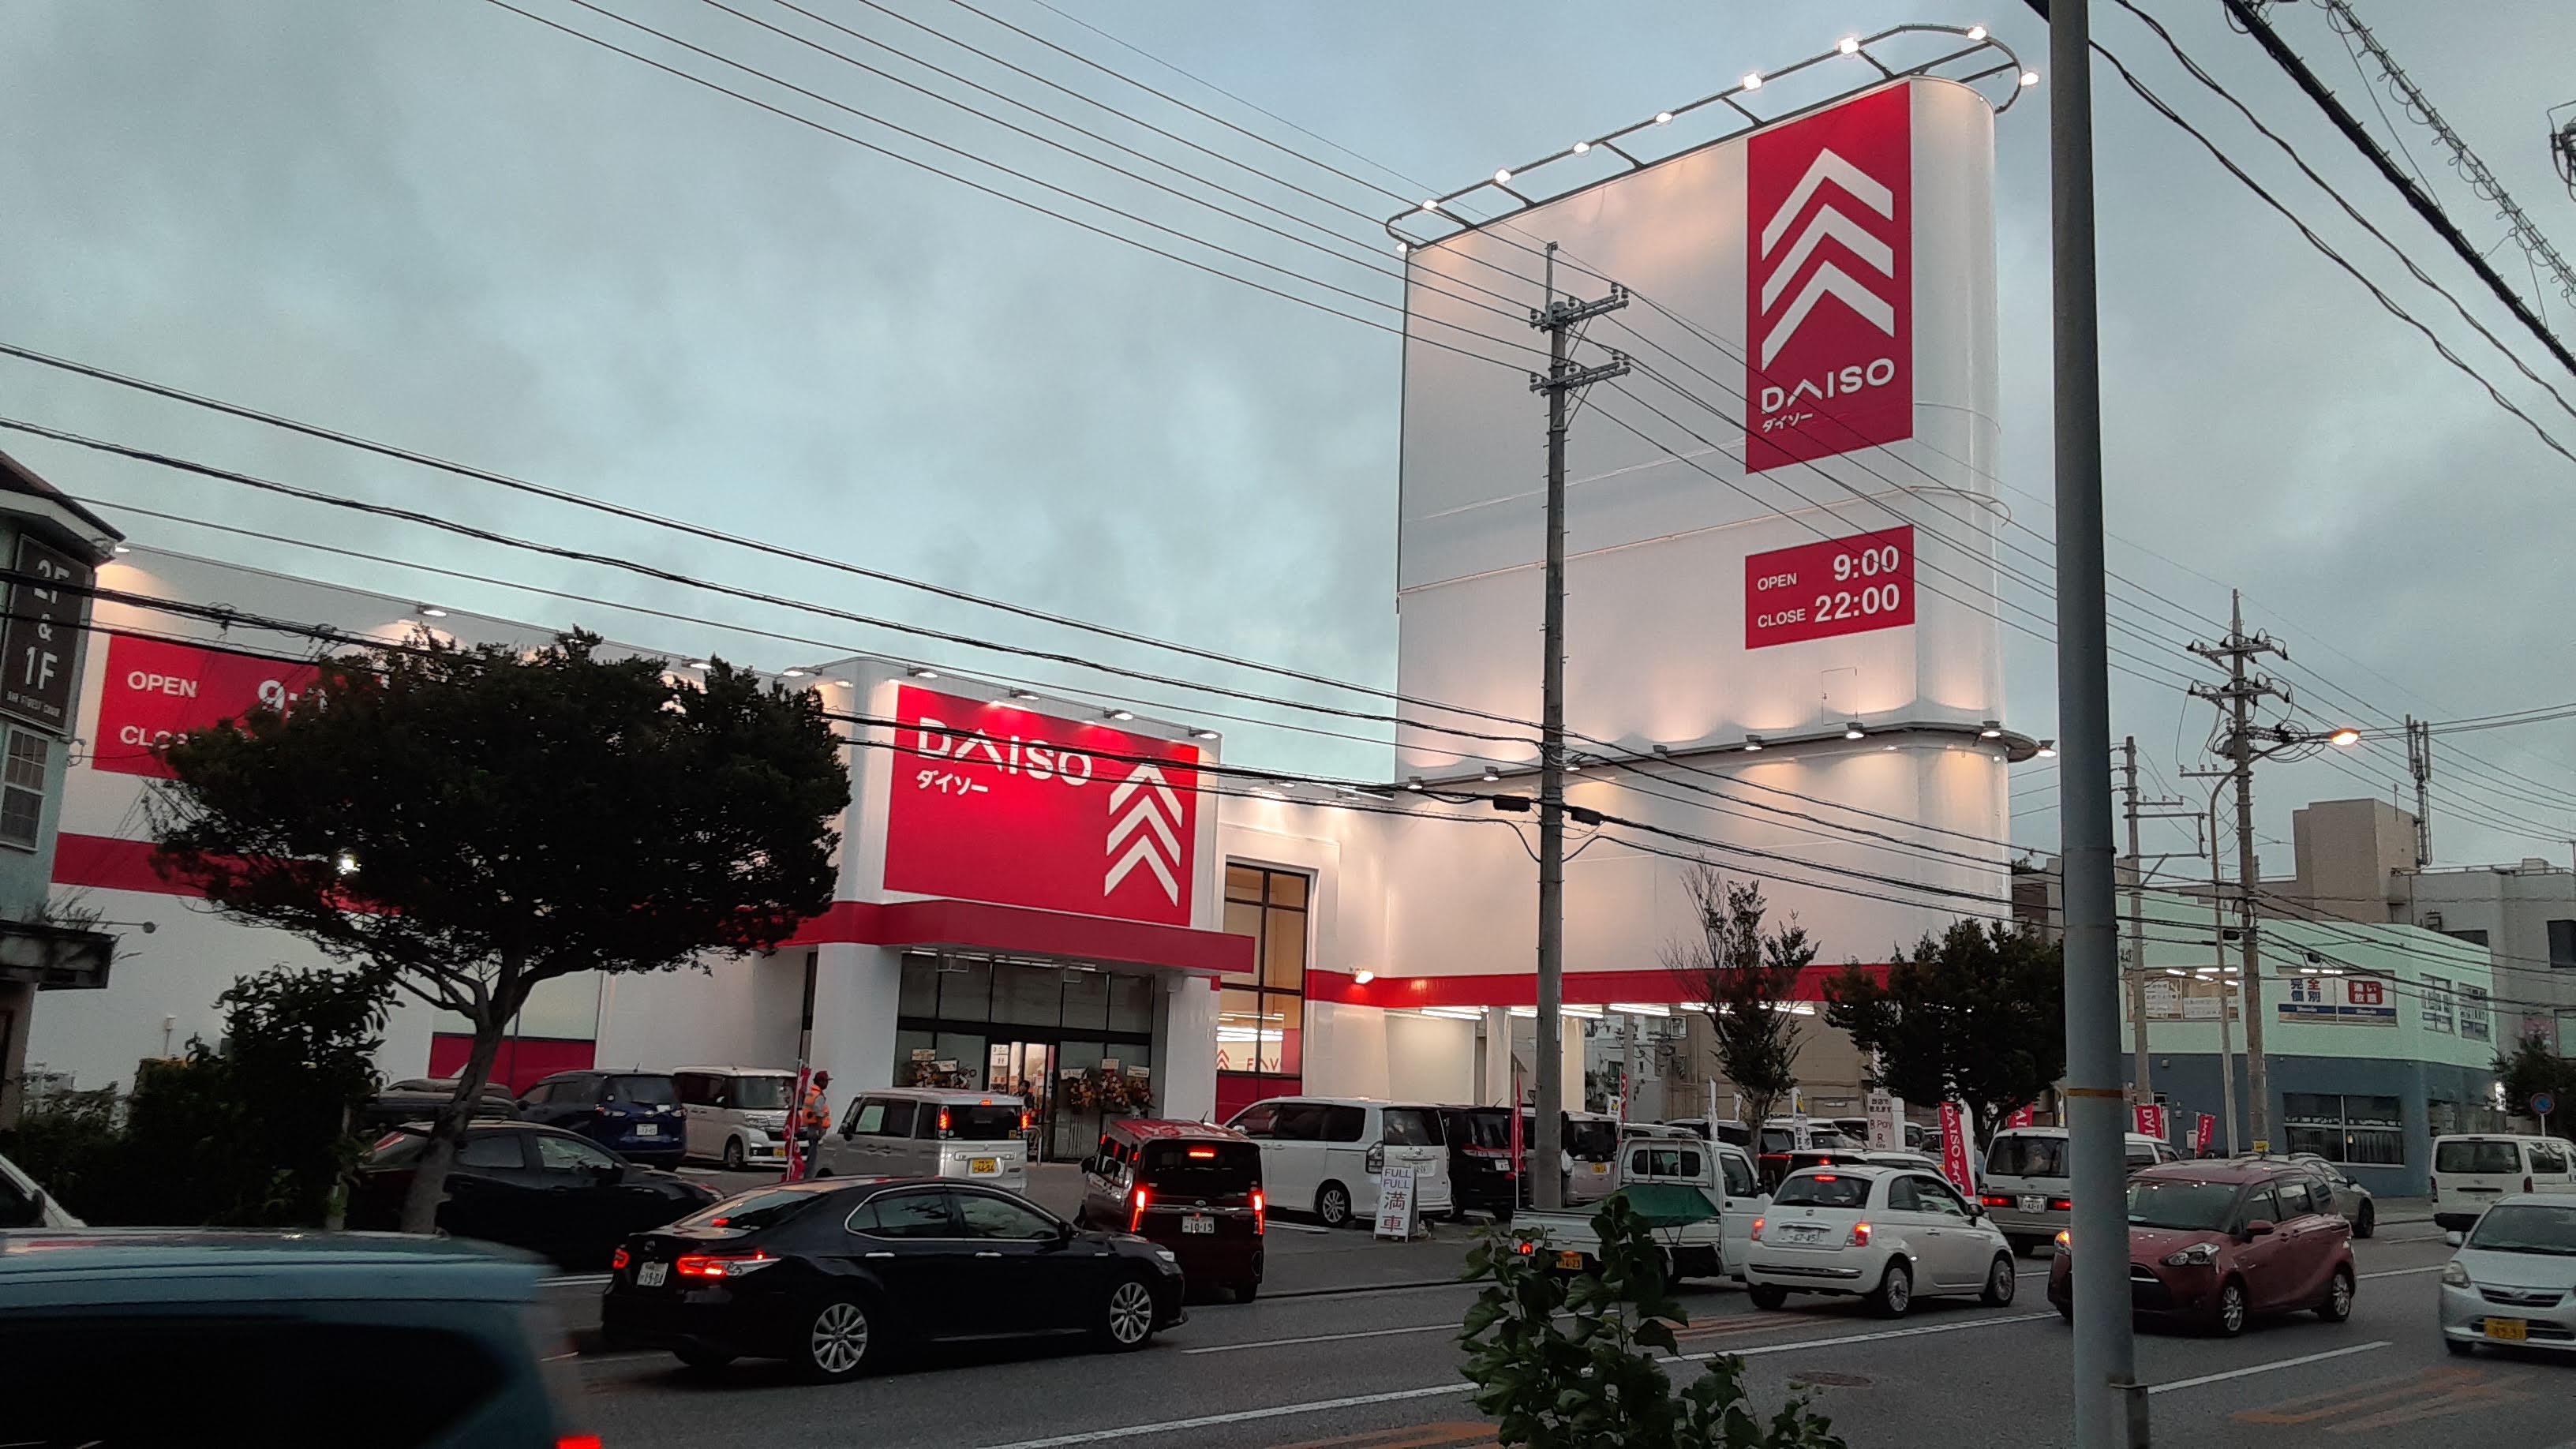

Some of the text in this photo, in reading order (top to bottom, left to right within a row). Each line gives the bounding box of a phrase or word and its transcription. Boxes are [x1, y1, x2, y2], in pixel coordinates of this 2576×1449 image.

[1762, 358, 1895, 414] DAISO
[1762, 413, 1813, 433] ダイソー
[1757, 545, 1899, 591] OPEN 9:00
[1758, 583, 1900, 628] CLOSE 22:00
[25, 646, 58, 690] 1F
[127, 671, 197, 698] OPEN
[918, 717, 1092, 786] DAISO
[916, 769, 988, 796] ダイソー
[1877, 1121, 1893, 1129] Pay
[1944, 1105, 1961, 1158] DAISO
[1383, 1179, 1410, 1189] FULL
[1384, 1168, 1412, 1178] FULL
[1380, 1191, 1407, 1232] 満車
